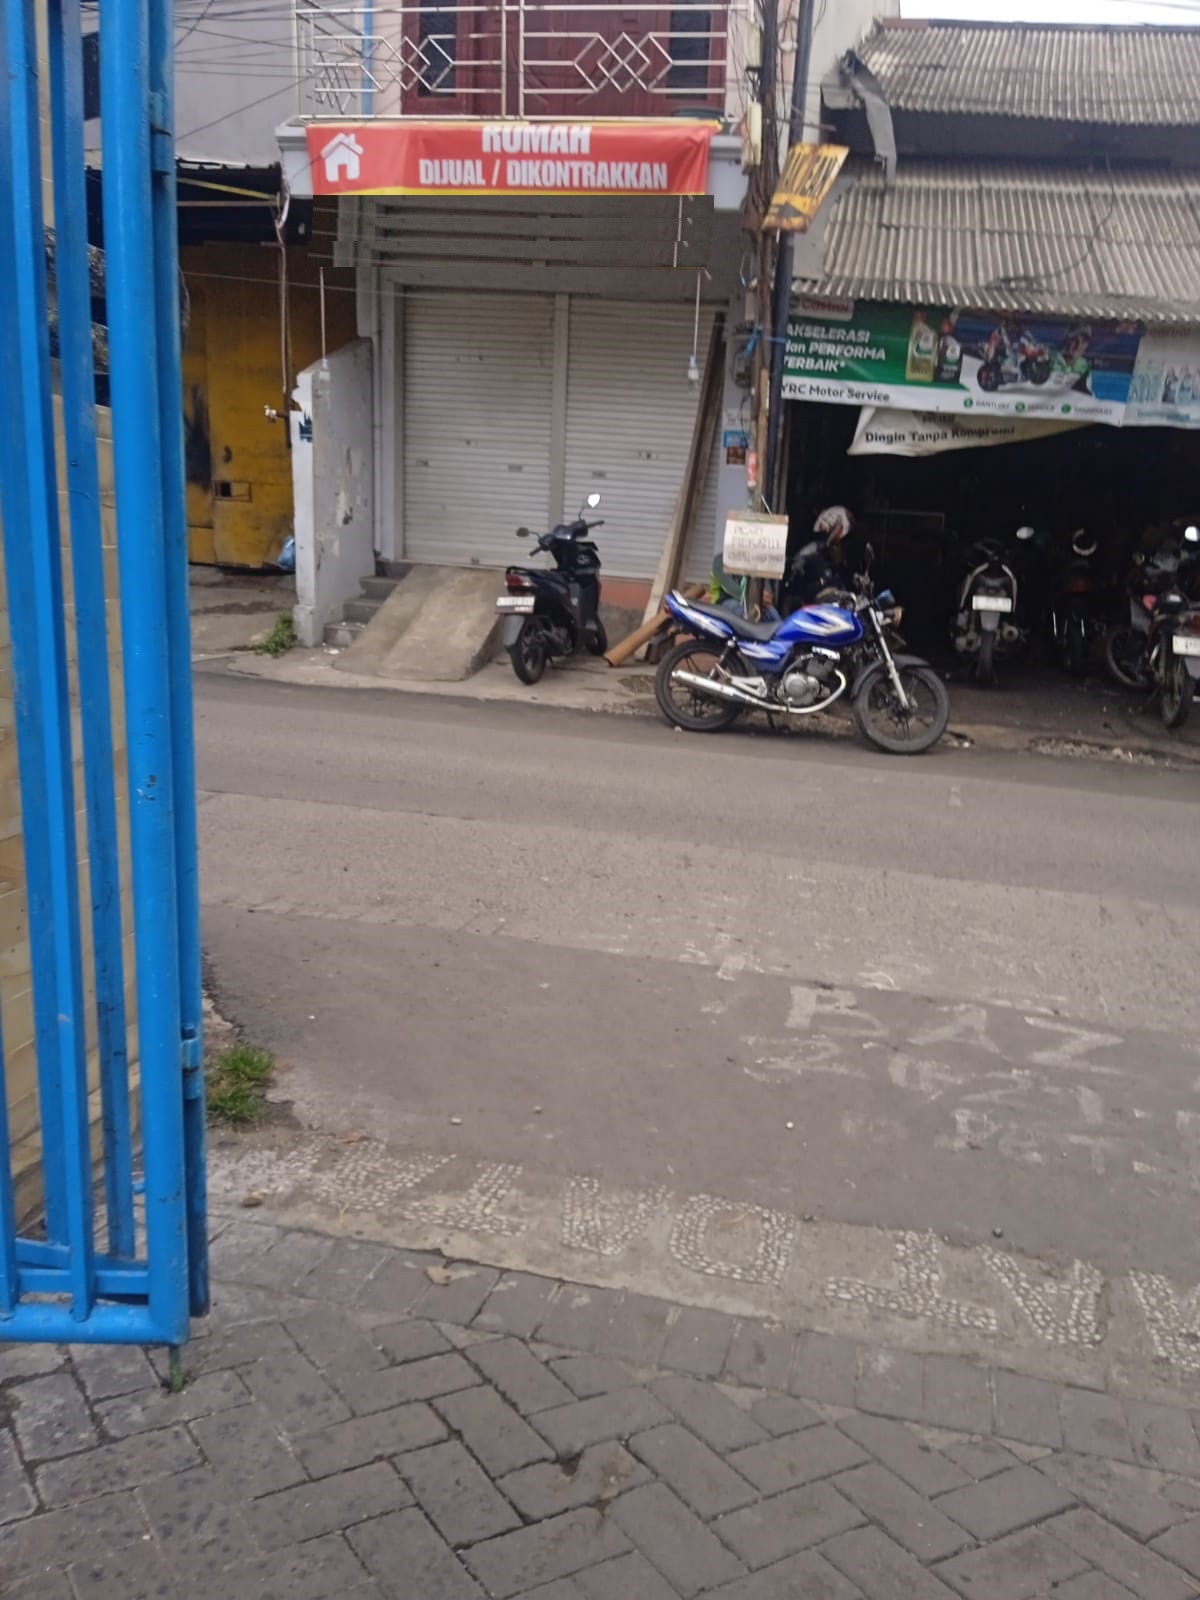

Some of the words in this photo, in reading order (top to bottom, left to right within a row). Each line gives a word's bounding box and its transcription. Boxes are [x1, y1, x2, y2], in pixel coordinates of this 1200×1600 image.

[482, 125, 592, 154] RUMAH
[419, 159, 486, 186] DIJUAL
[507, 160, 668, 189] DIKONTRAKKAN
[786, 323, 870, 343] AKSELERASI
[809, 342, 886, 361] PERFORMA
[809, 385, 843, 399] Motor
[847, 387, 890, 401] Service
[865, 431, 905, 445] Dingin
[911, 430, 947, 444] Tanpa
